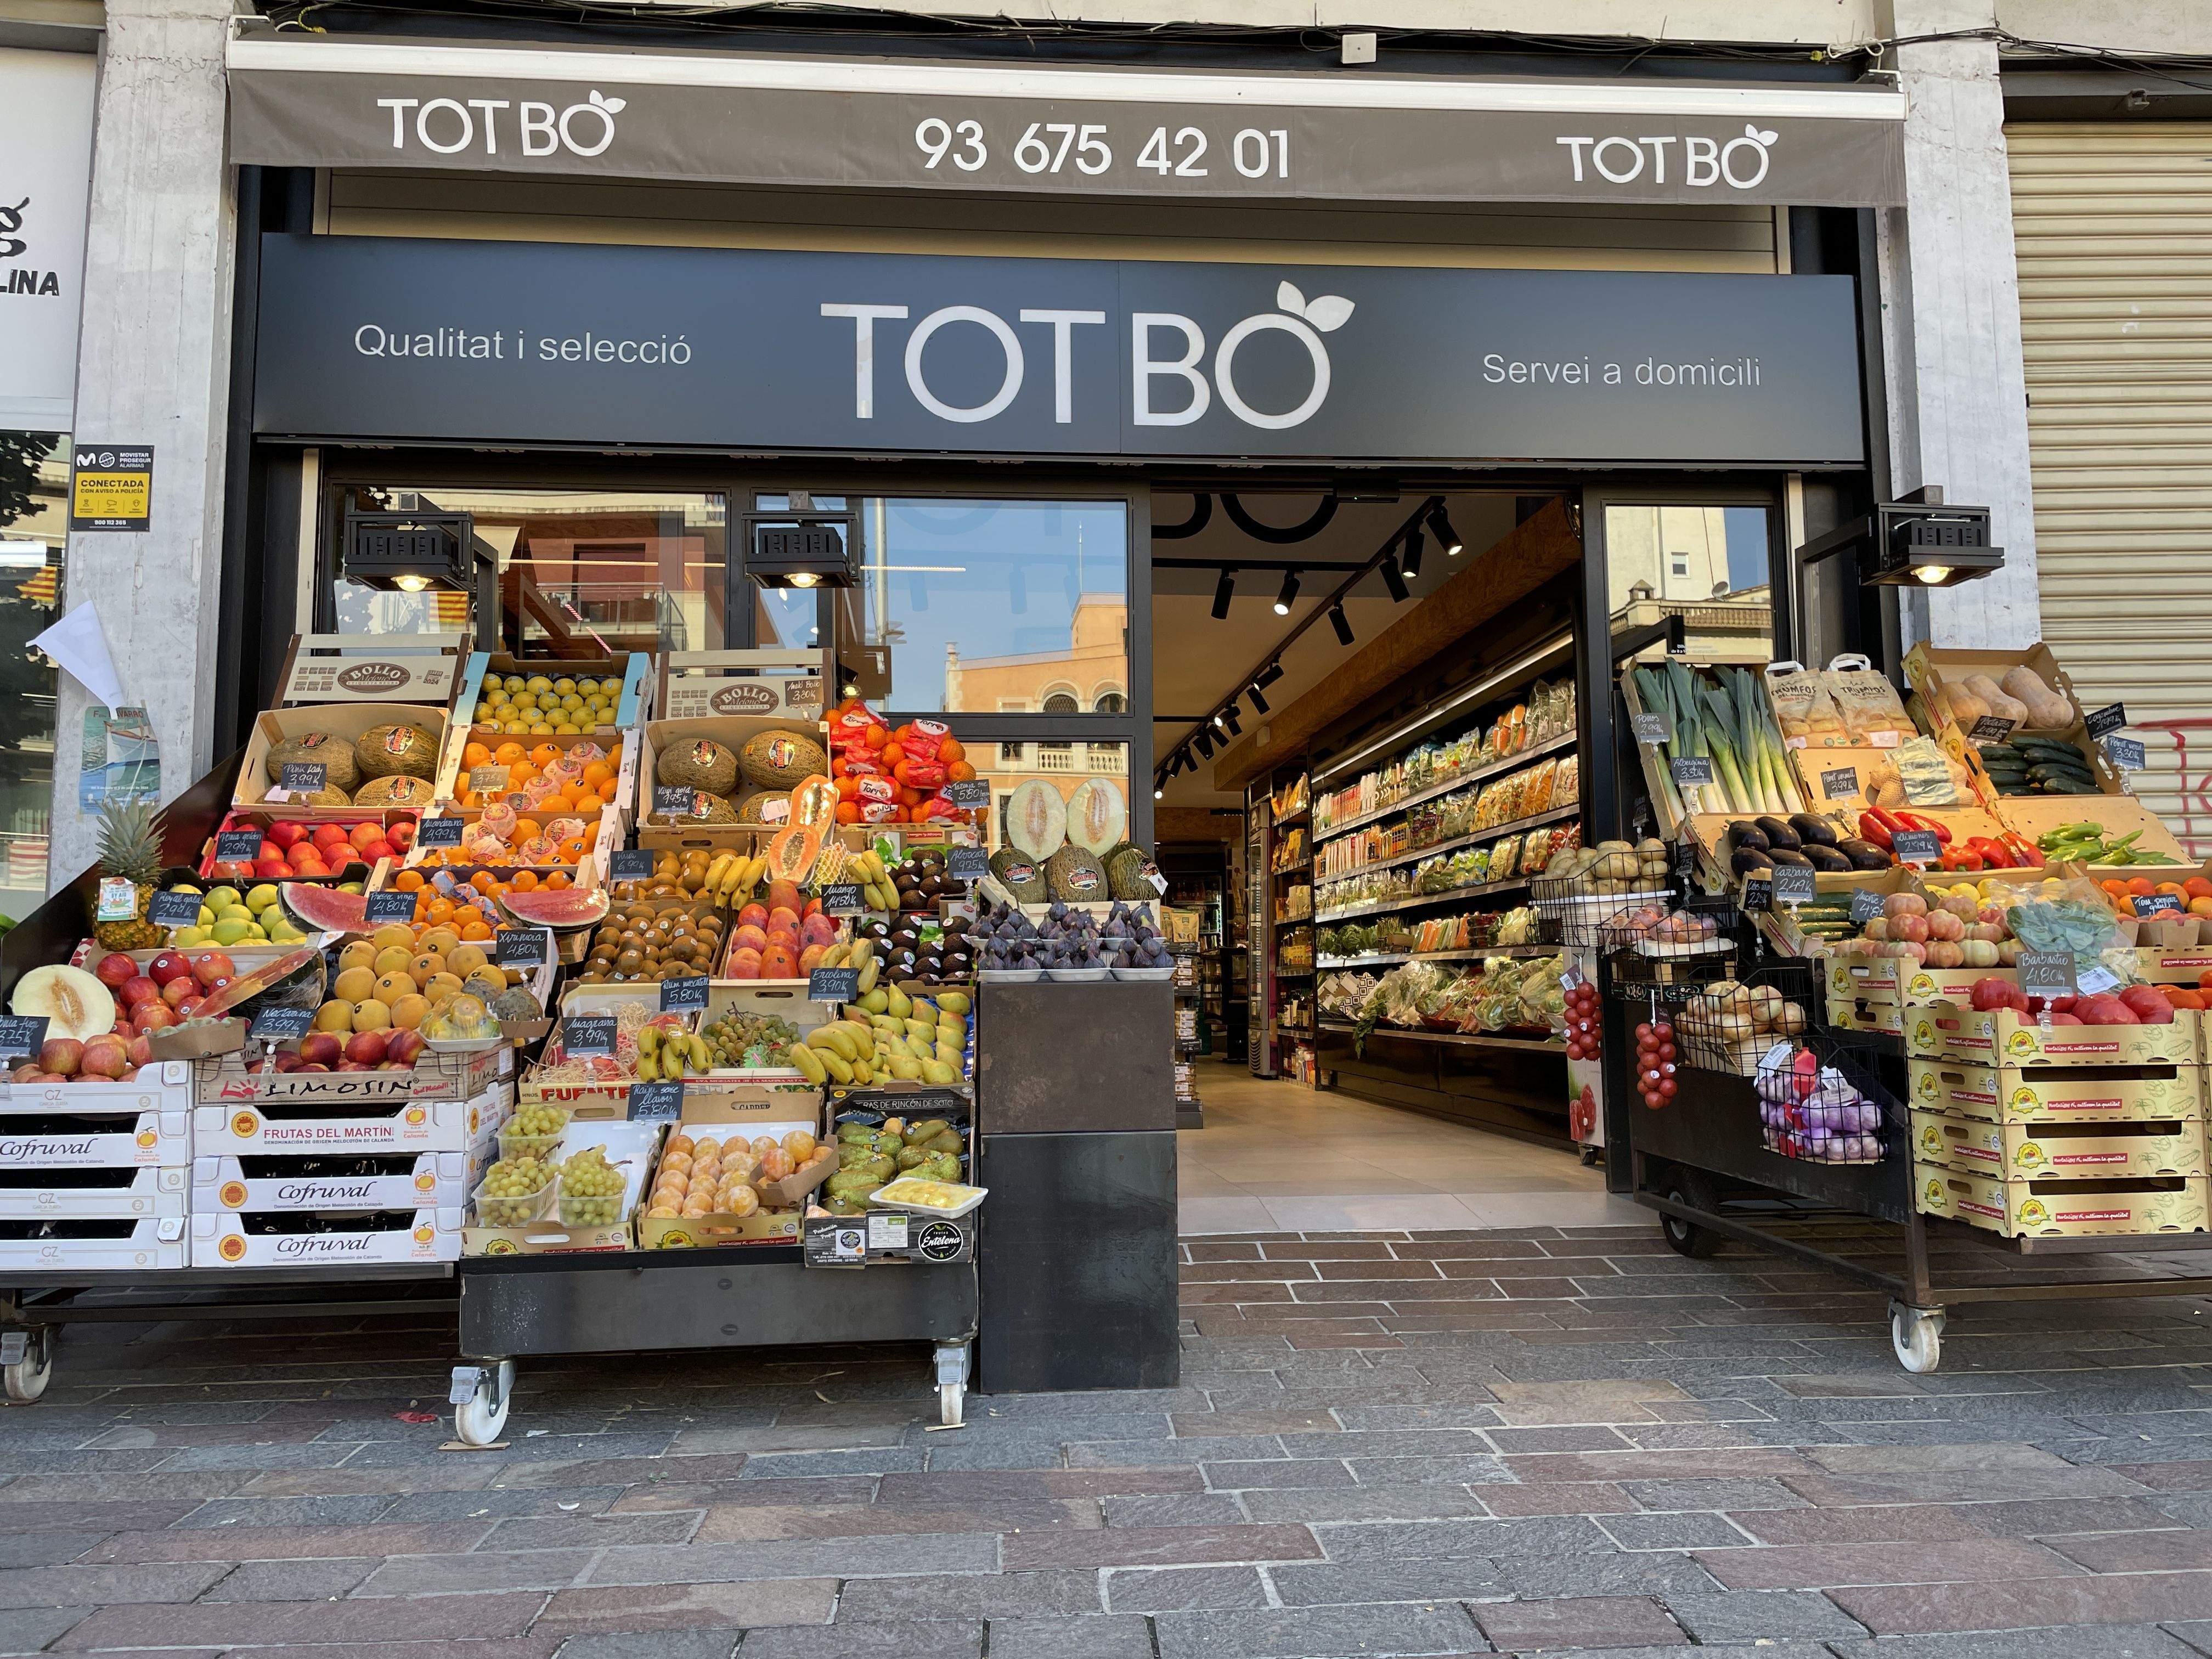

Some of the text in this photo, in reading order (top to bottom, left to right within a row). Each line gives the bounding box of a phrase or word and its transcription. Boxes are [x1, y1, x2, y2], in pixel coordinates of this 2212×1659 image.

[377, 98, 510, 154] TOT
[915, 117, 1290, 179] 93 675 42 01
[1556, 136, 1677, 184] TOT
[354, 324, 692, 364] Qualitat i selecció
[820, 302, 1107, 424] TOT
[1482, 353, 1760, 386] Servei a domicili
[351, 664, 402, 680] BOLLO
[721, 686, 770, 703] BOLLO
[862, 781, 888, 798] Torres
[1005, 867, 1033, 879] BOLLO
[471, 1067, 498, 1087] LIMO
[264, 1080, 413, 1097] LIMOSIN
[264, 1125, 392, 1138] FRUTAS DEL MARTÍN
[0, 1138, 99, 1160] Cofruval
[278, 1181, 378, 1204] Cofruval
[277, 1233, 377, 1257] Cofruval
